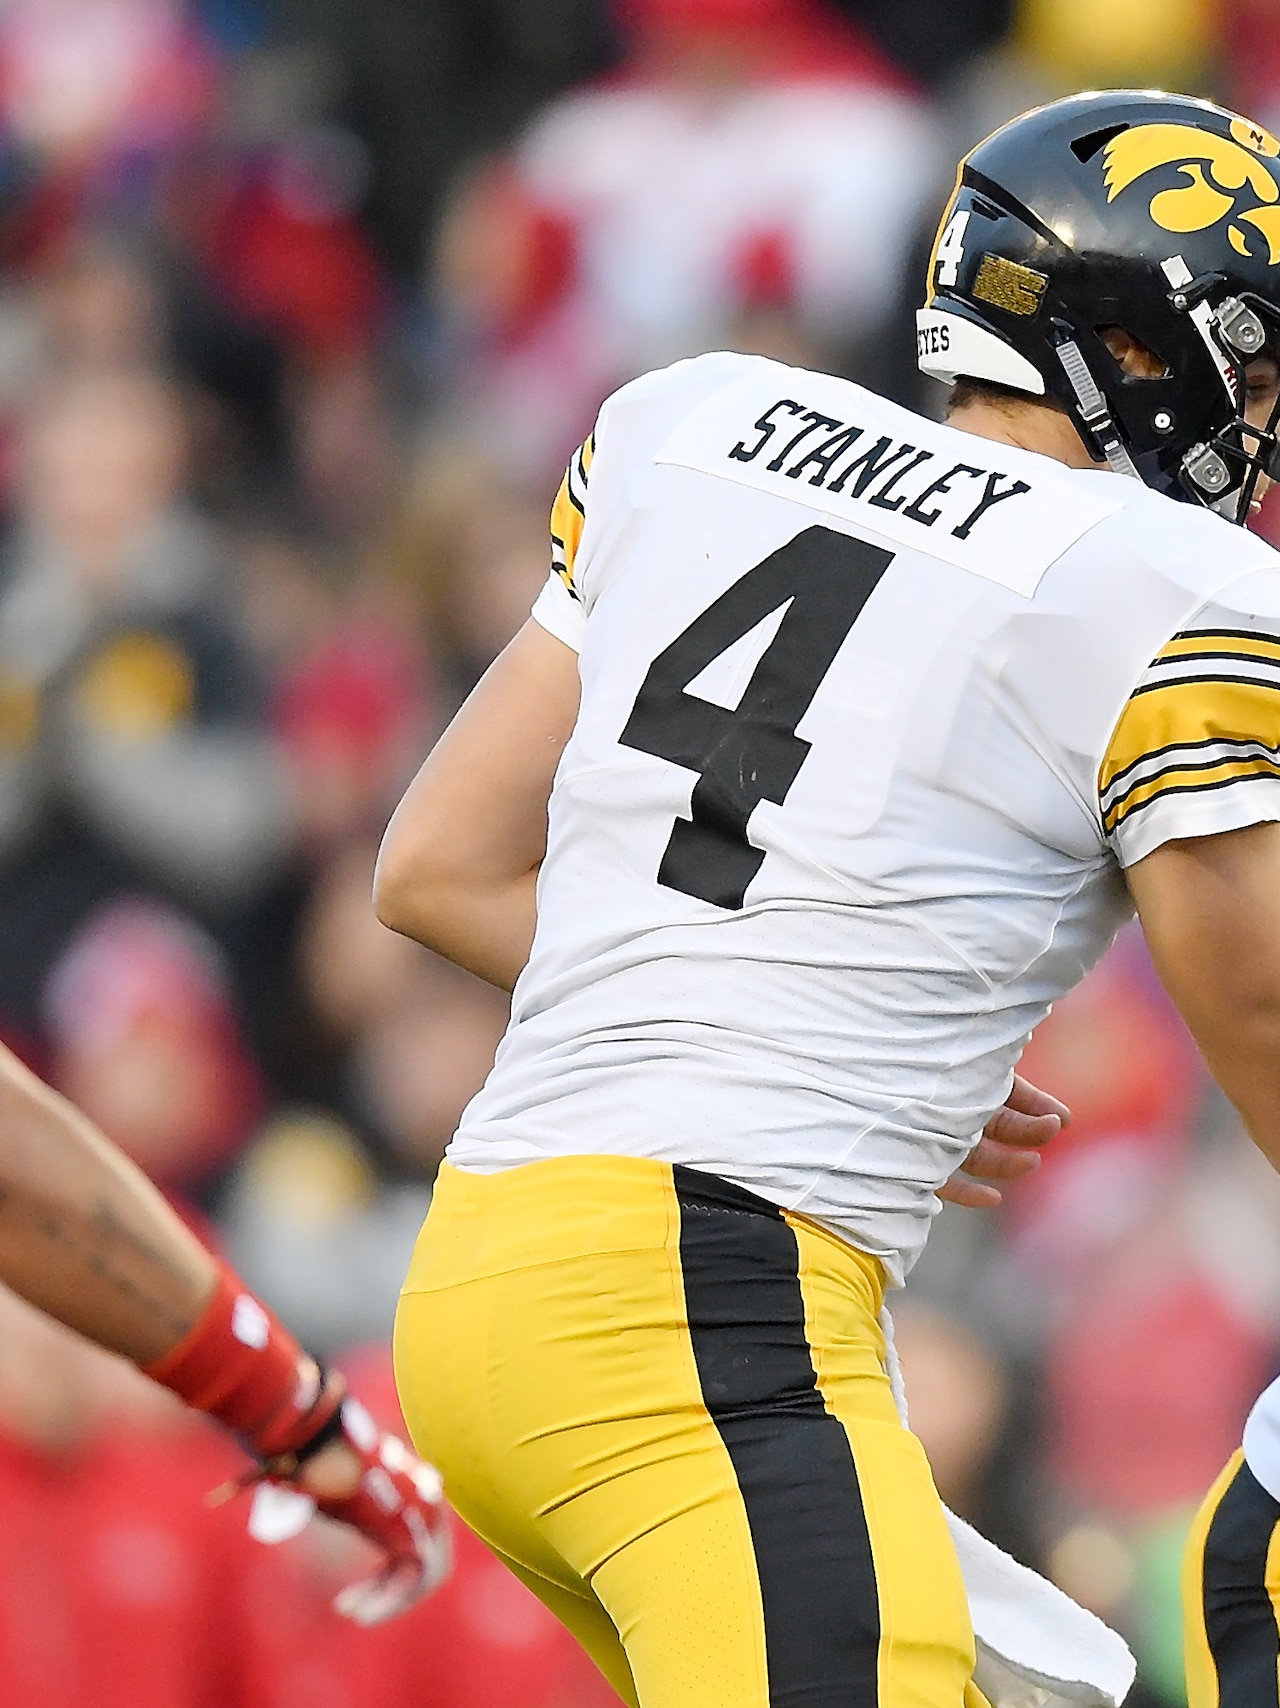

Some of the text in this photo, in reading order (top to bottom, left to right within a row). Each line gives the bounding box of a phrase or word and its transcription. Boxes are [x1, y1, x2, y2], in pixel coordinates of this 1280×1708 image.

[936, 210, 970, 286] 4
[728, 399, 1031, 540] STANLEY
[617, 524, 896, 911] 4
